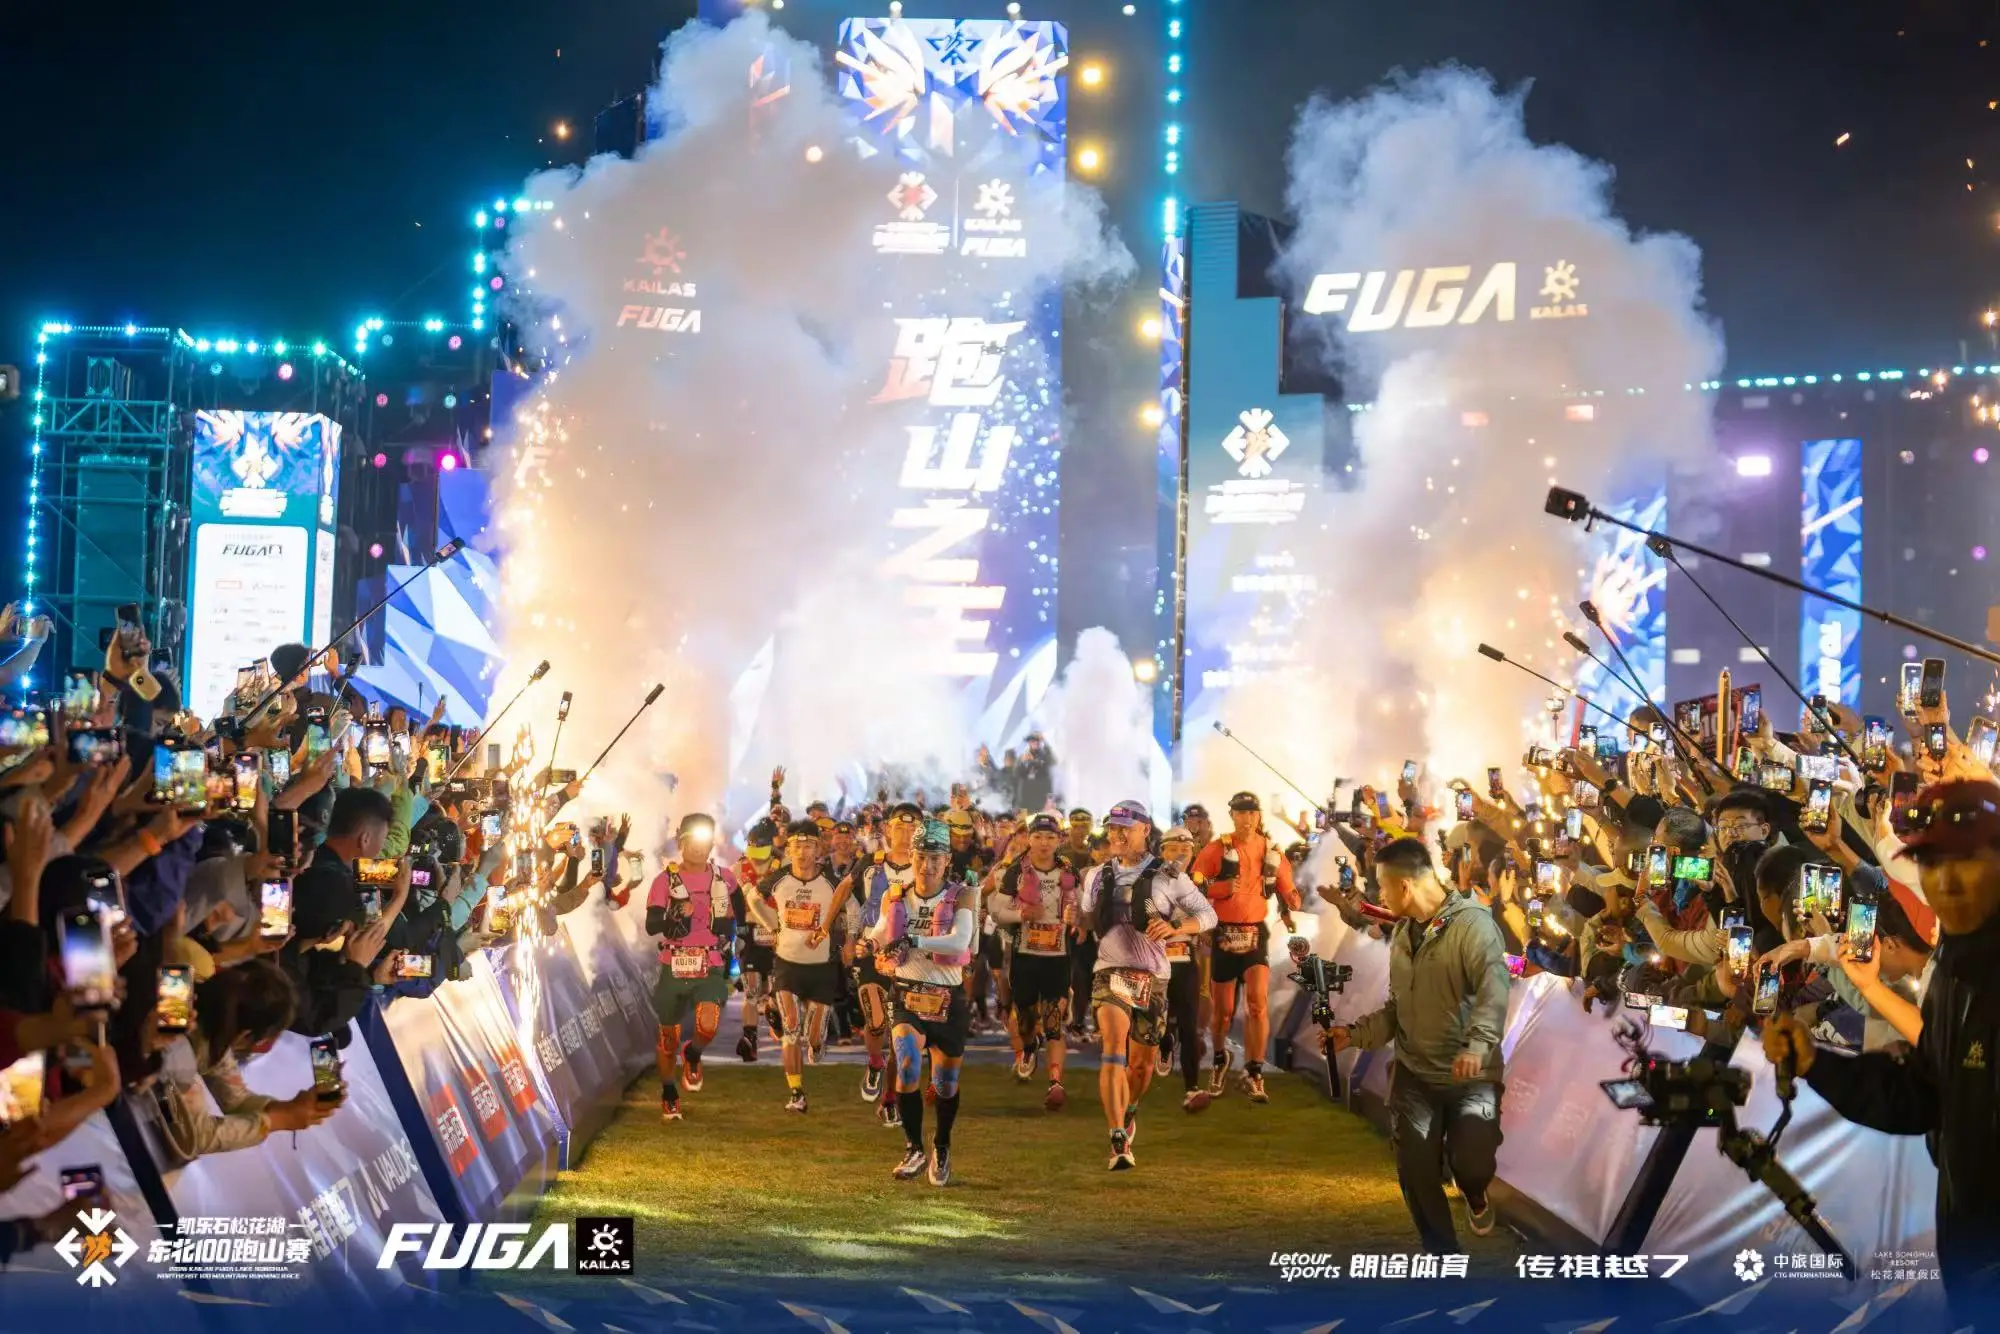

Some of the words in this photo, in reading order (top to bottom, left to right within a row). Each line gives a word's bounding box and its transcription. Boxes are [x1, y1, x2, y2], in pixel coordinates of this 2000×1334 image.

[624, 279, 697, 298] KAILAS
[1303, 262, 1516, 332] FUGA
[616, 304, 702, 333] FUGA
[868, 318, 1027, 676] 跑山之王
[907, 918, 933, 930] FUG
